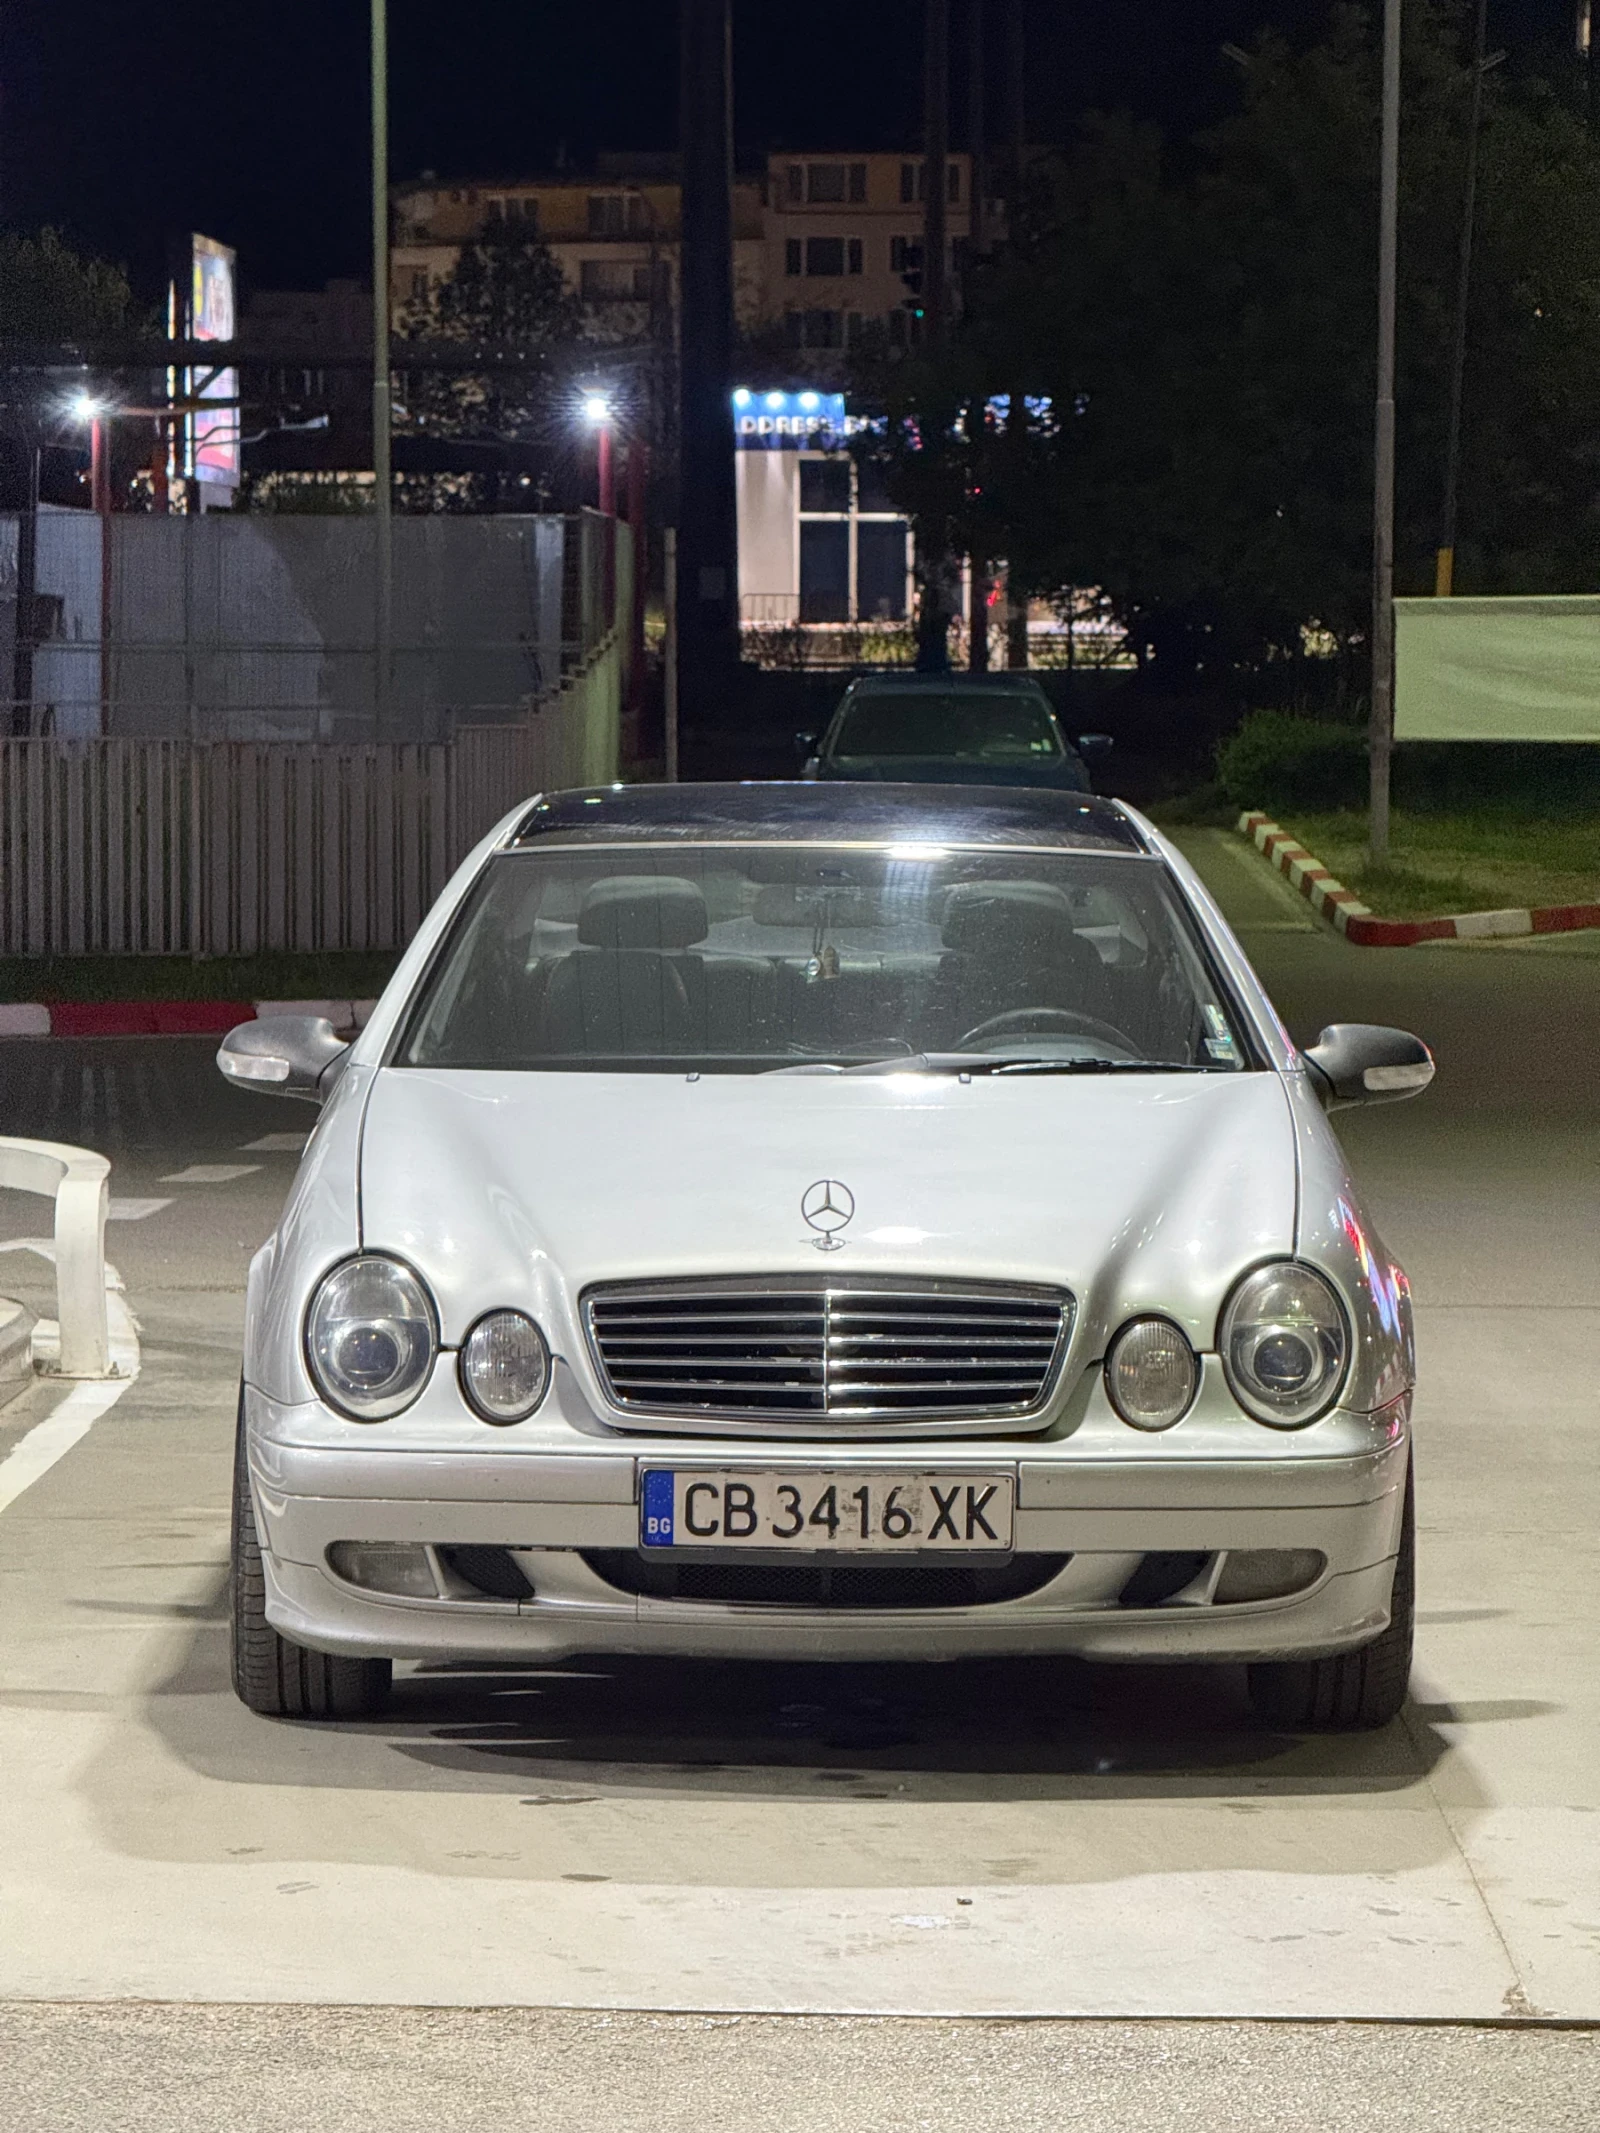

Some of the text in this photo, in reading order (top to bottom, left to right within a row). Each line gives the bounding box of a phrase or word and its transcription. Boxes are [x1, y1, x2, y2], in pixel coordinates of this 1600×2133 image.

[647, 1516, 671, 1534] BG
[685, 1482, 999, 1540] CB 3416 XK
